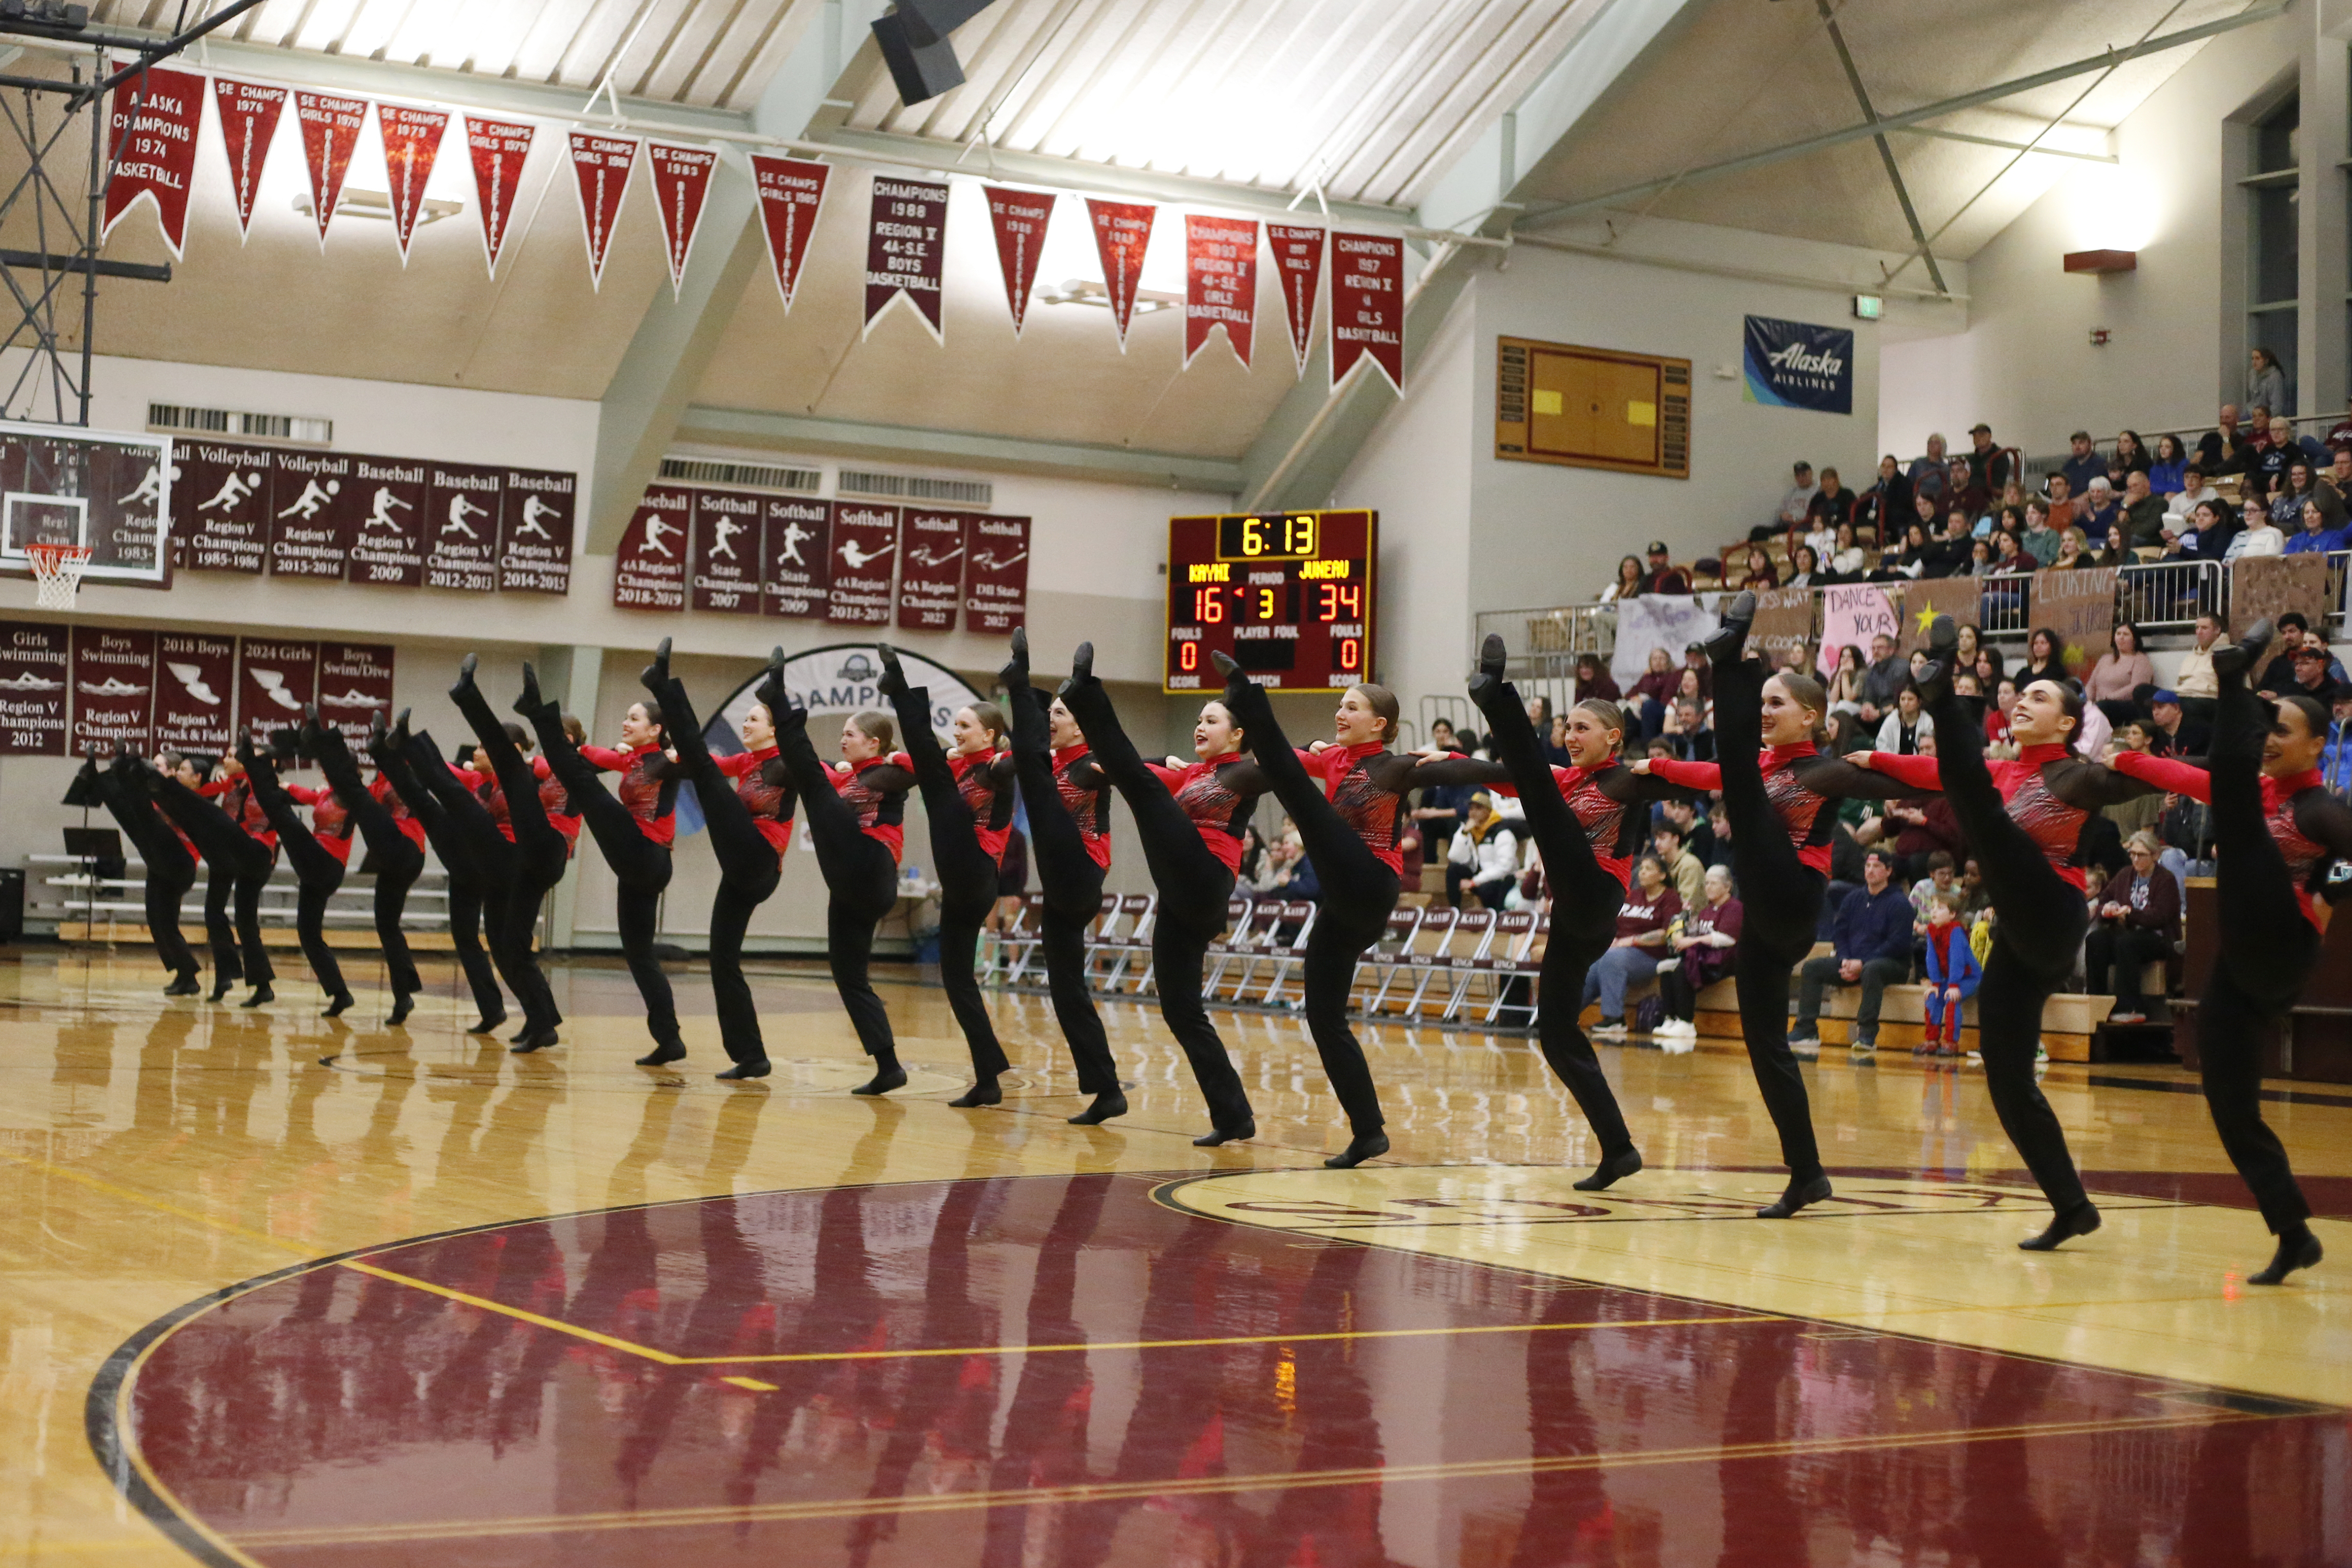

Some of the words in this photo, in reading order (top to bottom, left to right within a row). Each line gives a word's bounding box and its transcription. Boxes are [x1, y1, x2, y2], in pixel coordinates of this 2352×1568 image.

[218, 82, 234, 95] SE
[241, 86, 284, 102] CHAMPS
[237, 100, 263, 113] 1976
[301, 95, 316, 106] SE
[320, 98, 363, 115] CHAMPS
[300, 108, 332, 123] GIRLS
[382, 108, 396, 120] SE
[400, 110, 445, 127] CHAMPS
[469, 121, 483, 133] SE
[489, 124, 531, 140] CHAMPS
[135, 137, 166, 158] 1974
[470, 135, 499, 150] GIRLS
[572, 137, 585, 148] SE
[591, 139, 633, 155] CHAMPS
[573, 150, 602, 164] GIRLS
[653, 148, 668, 159] SE
[671, 150, 712, 166] CHAMPS
[760, 171, 775, 183] SE
[777, 175, 817, 191] CHAMPS
[760, 187, 791, 202] GIRLS
[873, 182, 947, 203] CHAMPIONS
[875, 221, 922, 239] REGION
[1191, 225, 1253, 245] CHAMPIONS
[1338, 239, 1396, 257] CHAMPIONS
[887, 256, 921, 273] BOYS
[867, 271, 940, 291] BASKETBALL
[1769, 342, 1842, 378] Alaska
[1773, 373, 1836, 391] AIRLINES
[198, 445, 270, 468] Volleyball
[278, 454, 349, 476] Volleyball
[357, 462, 424, 483] Baseball
[434, 470, 499, 492] Baseball
[509, 472, 572, 493] Baseball
[639, 493, 687, 511] aseball
[701, 495, 757, 514] Softball
[769, 502, 825, 521] Softball
[840, 509, 893, 527] Softball
[205, 518, 246, 536] Region
[246, 522, 255, 536] V
[914, 517, 958, 532] Softball
[978, 520, 1022, 537] Softball
[192, 533, 264, 553] Champions
[285, 526, 326, 542] Region
[325, 529, 335, 542] V
[358, 533, 402, 549] Region
[406, 537, 416, 550] V
[1243, 516, 1313, 556] 6:13
[273, 542, 344, 560] Champions
[350, 548, 421, 567] Champions
[435, 540, 479, 557] Region
[482, 544, 492, 557] V
[508, 541, 551, 558] Region
[555, 546, 564, 559] V
[198, 551, 259, 569] 1985-1986
[277, 559, 339, 575] 2015-2016
[501, 556, 569, 574] Champions
[638, 560, 674, 575] Region
[369, 566, 403, 581] 2009
[711, 563, 741, 577] State
[780, 569, 810, 583] State
[1189, 563, 1230, 582] KAYHI
[1248, 572, 1285, 585] PERIOD
[1299, 560, 1349, 579] JUNEAU
[430, 572, 492, 591] 2012-2013
[503, 573, 566, 591] 2014-2015
[695, 575, 759, 592] Champions
[765, 581, 827, 599] Champions
[835, 578, 849, 589] 4A
[850, 577, 885, 592] Region
[903, 580, 919, 592] 4A
[921, 581, 955, 595] Region
[617, 588, 682, 606] 2018-2019
[710, 592, 740, 608] 2007
[780, 599, 809, 613] 2009
[1195, 586, 1223, 623] 16
[1259, 589, 1274, 618] 3
[1320, 584, 1358, 620] 34
[1831, 586, 1876, 613] DANCE
[1233, 626, 1270, 639] PLAYER
[1274, 626, 1299, 639] FOUL
[1330, 625, 1362, 638] FOULS
[1854, 612, 1892, 636] YOUR
[13, 631, 49, 647] Girls
[1172, 628, 1202, 640] FOULS
[101, 635, 132, 652] Boys
[163, 638, 194, 653] 2018
[198, 640, 229, 659] Boys
[245, 643, 276, 660] 2024
[280, 647, 312, 661] Girls
[81, 648, 150, 668] Swimming
[343, 648, 372, 664] Boys
[1181, 642, 1196, 670] 0
[1341, 639, 1357, 668] 0
[324, 661, 390, 679] Swim/Dive
[1169, 675, 1200, 688] SCORE
[1329, 674, 1362, 687] SCORE
[48, 701, 58, 715] V
[86, 708, 129, 725] Region
[130, 710, 140, 723] V
[168, 711, 207, 729] Region
[210, 713, 218, 726] V
[252, 717, 289, 732] Region
[291, 719, 301, 731] V
[11, 731, 43, 747] 2012
[75, 721, 148, 739] Champions
[189, 729, 200, 742] &
[1224, 1189, 2109, 1223] KINGS
